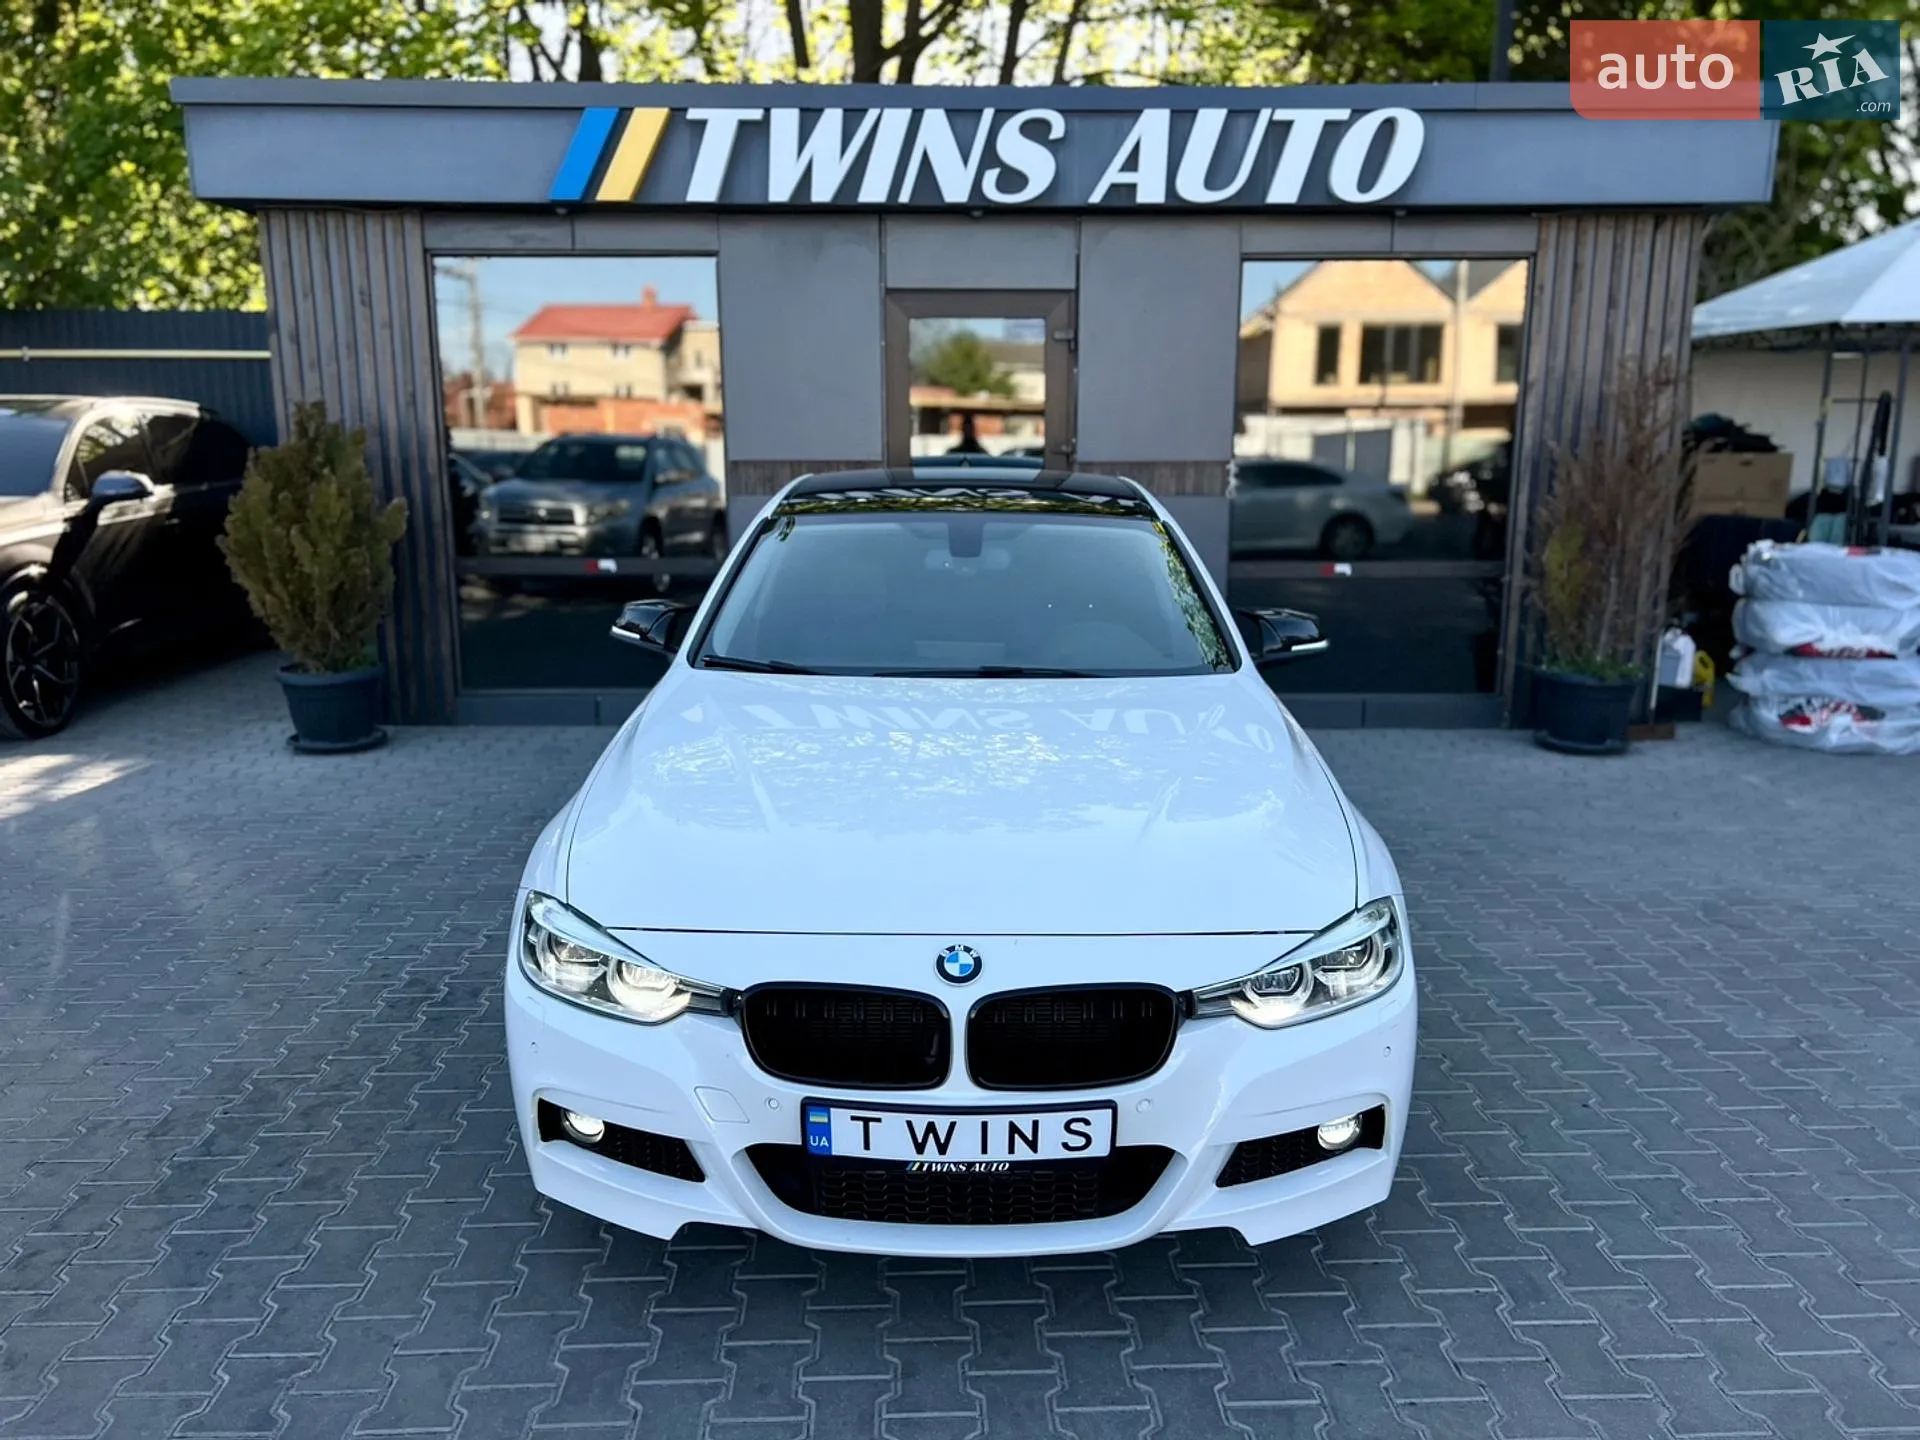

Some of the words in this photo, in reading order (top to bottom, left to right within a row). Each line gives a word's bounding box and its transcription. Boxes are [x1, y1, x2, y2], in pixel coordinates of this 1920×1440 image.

[685, 107, 1065, 203] TWINS
[1087, 107, 1425, 204] AUTO
[809, 1135, 829, 1147] UA
[850, 1115, 1093, 1156] TWINS
[922, 1162, 968, 1173] TWINS
[970, 1162, 1010, 1173] AUTO
